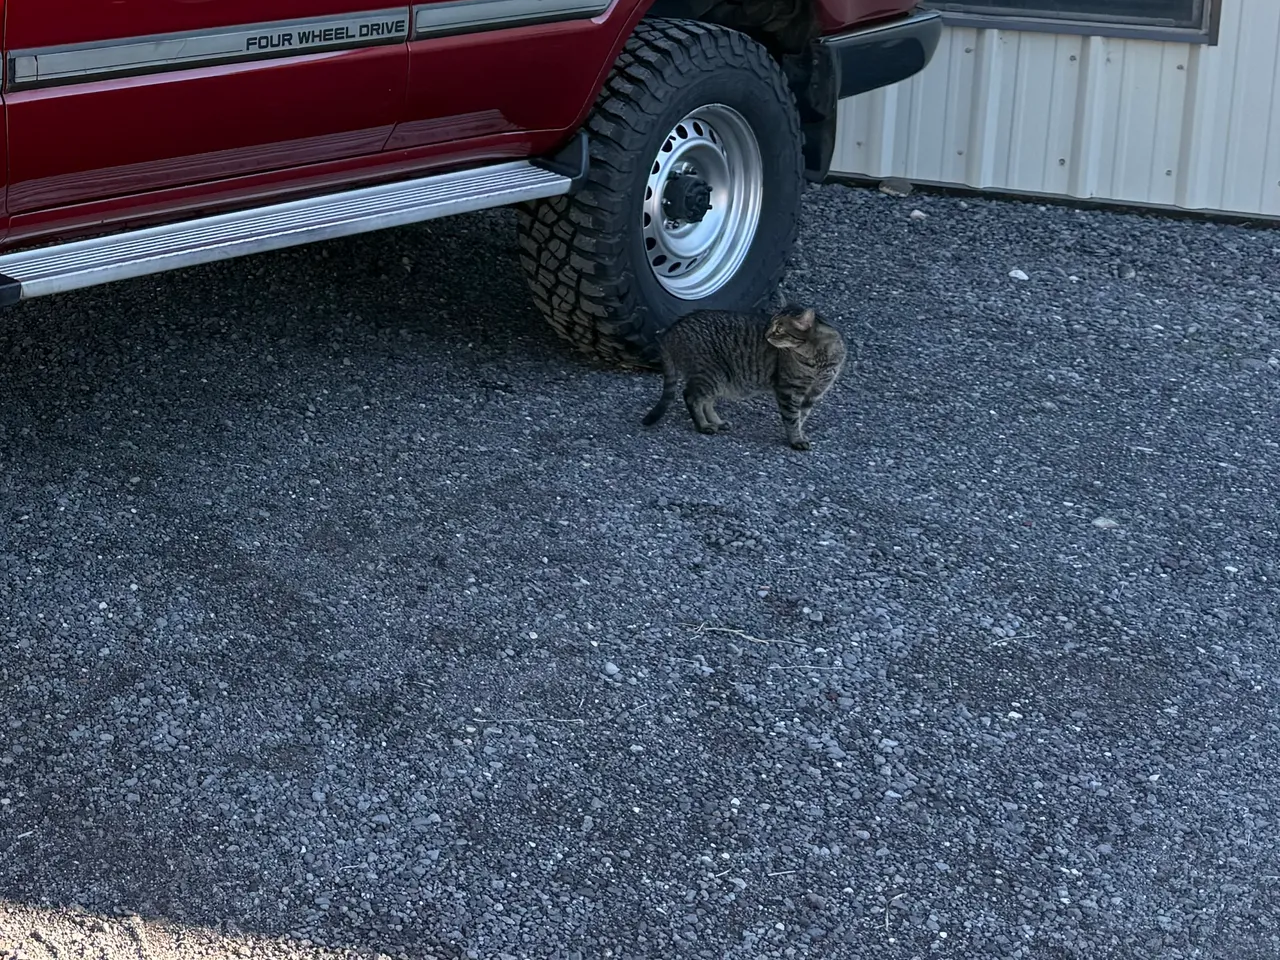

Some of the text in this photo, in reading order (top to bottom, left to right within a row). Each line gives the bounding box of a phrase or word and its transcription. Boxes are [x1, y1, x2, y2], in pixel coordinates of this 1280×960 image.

[246, 20, 406, 51] FOUR WHEEL DRIVE
